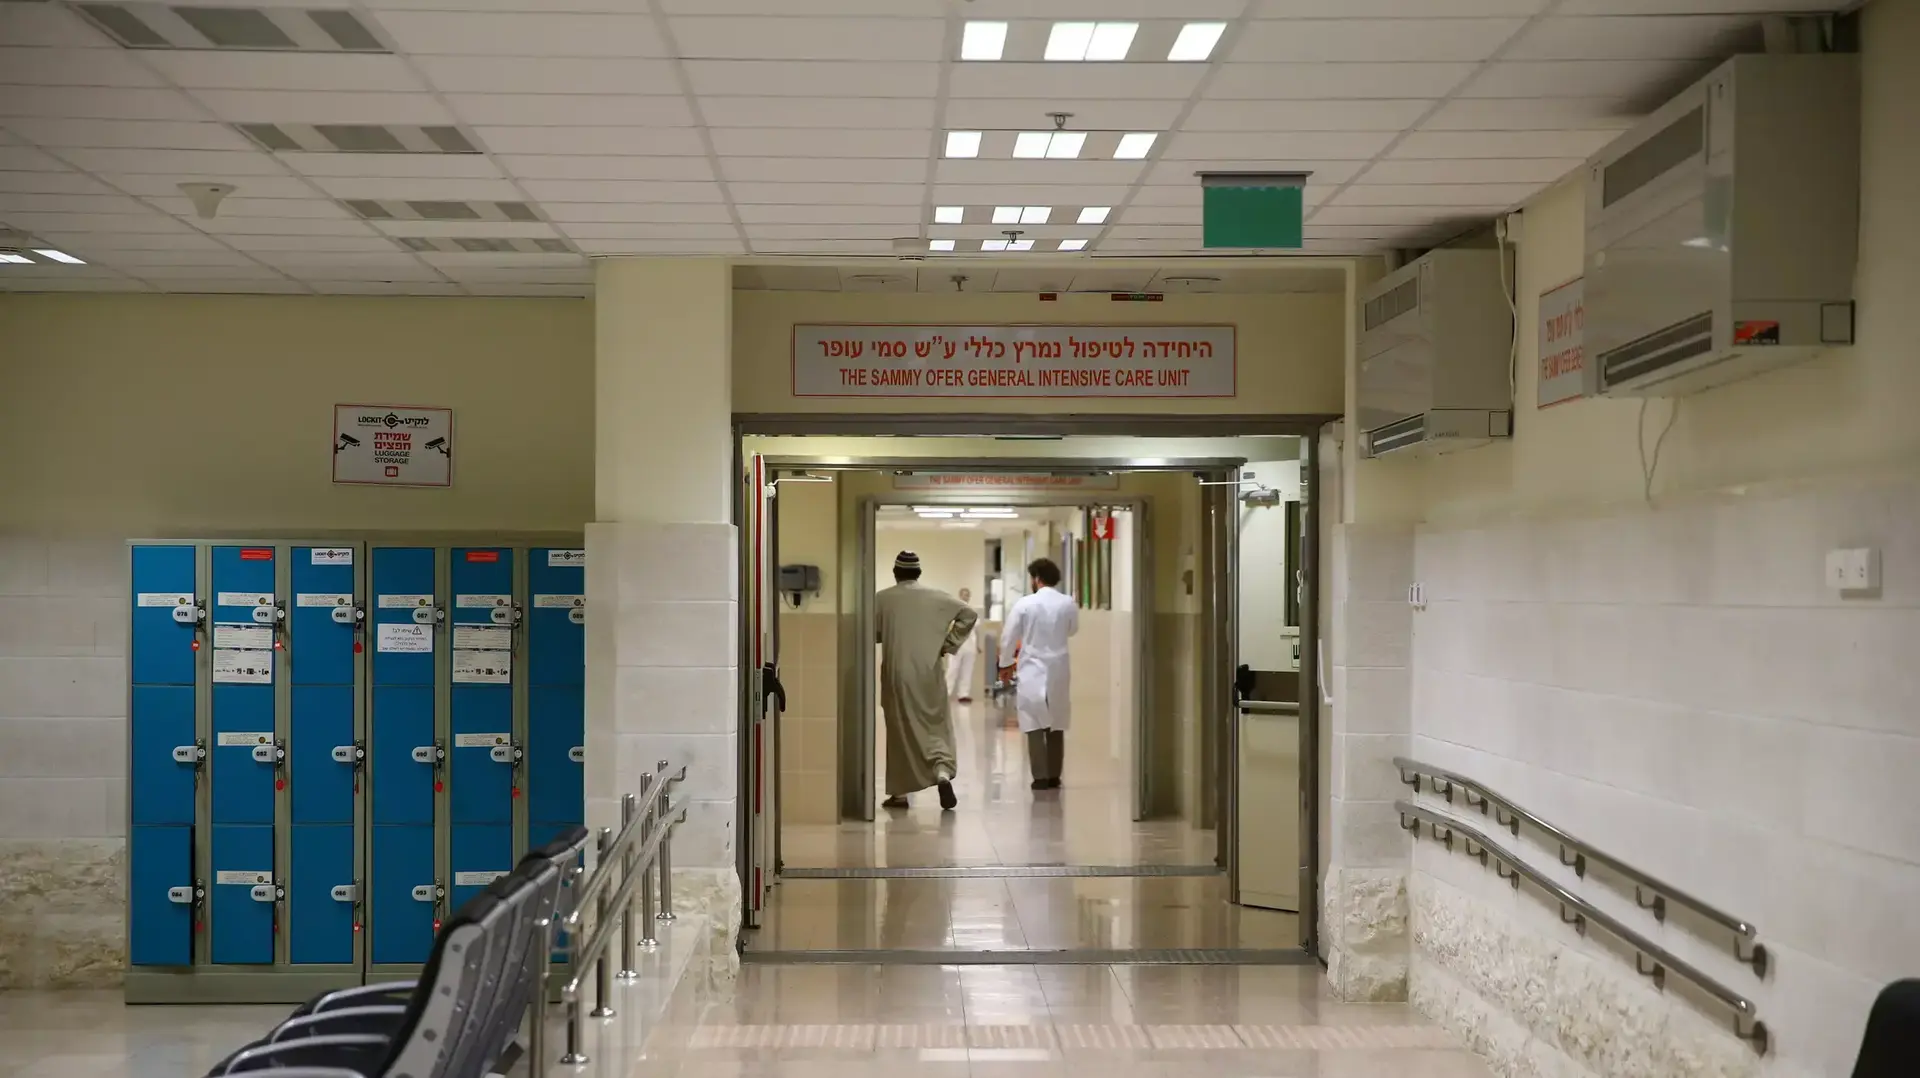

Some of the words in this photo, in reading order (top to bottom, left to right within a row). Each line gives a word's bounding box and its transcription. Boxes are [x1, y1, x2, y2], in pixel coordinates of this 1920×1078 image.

[818, 341, 863, 359] עופר
[871, 341, 907, 358] סמי
[964, 336, 1006, 358] כללי
[1013, 341, 1062, 363] נמרץ
[1068, 336, 1136, 359] לטיפול
[1143, 341, 1213, 358] היחידה
[839, 368, 867, 386] THE
[870, 368, 922, 386] SAMMY
[926, 368, 964, 387] OFER
[967, 369, 1034, 387] GENERAL
[1038, 369, 1112, 387] INTENSIVE
[1115, 369, 1154, 387] CARE
[1158, 369, 1190, 386] UNIT
[358, 416, 382, 424] LOCKIT
[404, 417, 429, 426] לוקיט
[374, 432, 411, 441] שמירת
[374, 441, 411, 450] חפצים
